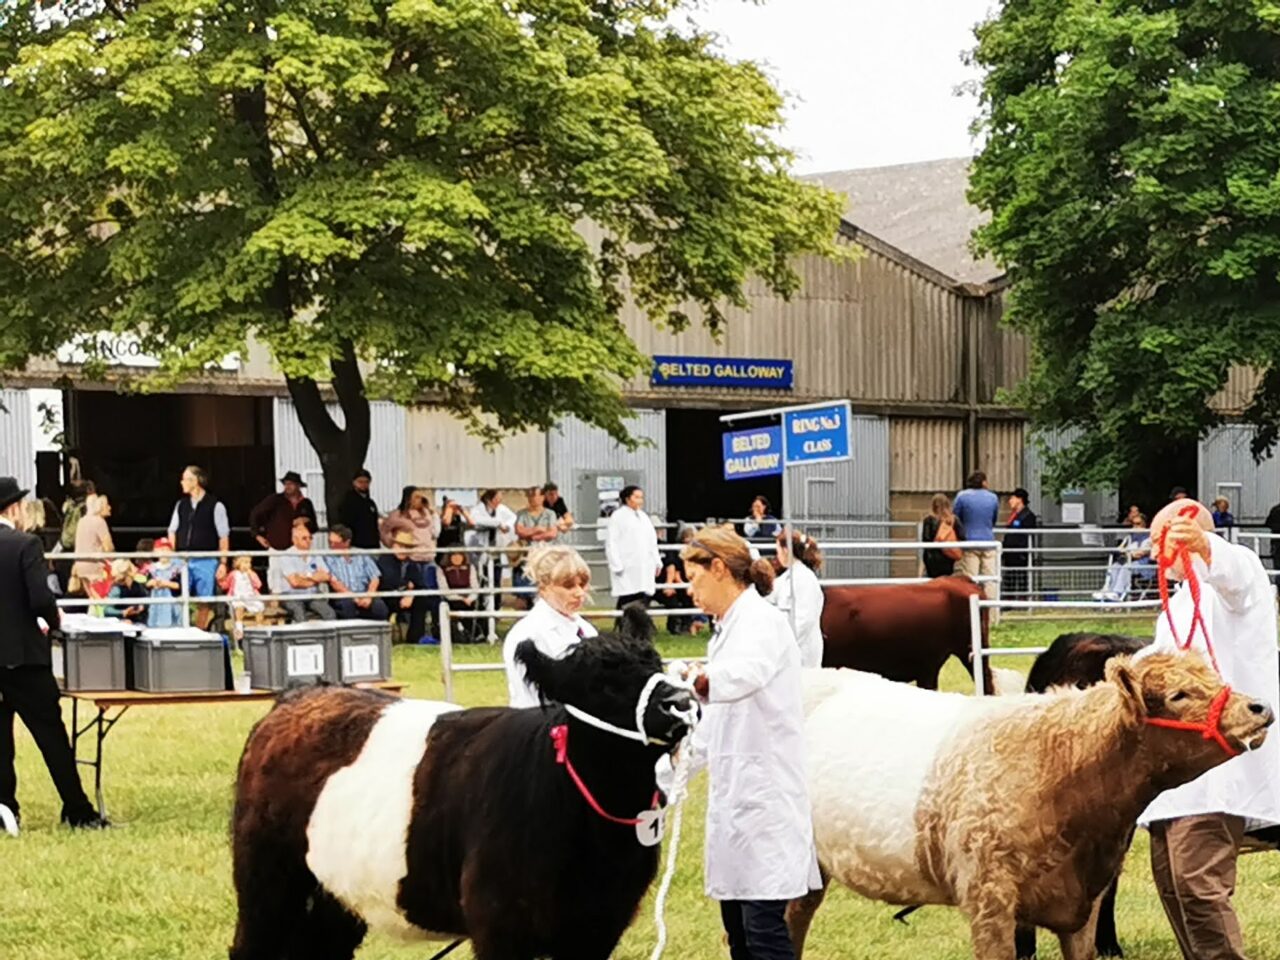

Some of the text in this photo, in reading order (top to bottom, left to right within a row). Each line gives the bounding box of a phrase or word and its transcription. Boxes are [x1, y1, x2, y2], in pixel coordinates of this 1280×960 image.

[660, 363, 785, 378] BELTED GALLOWAY
[792, 417, 820, 434] RING
[732, 433, 771, 453] BELTED
[803, 438, 832, 453] CLASS
[725, 453, 780, 474] GALLOWAY
